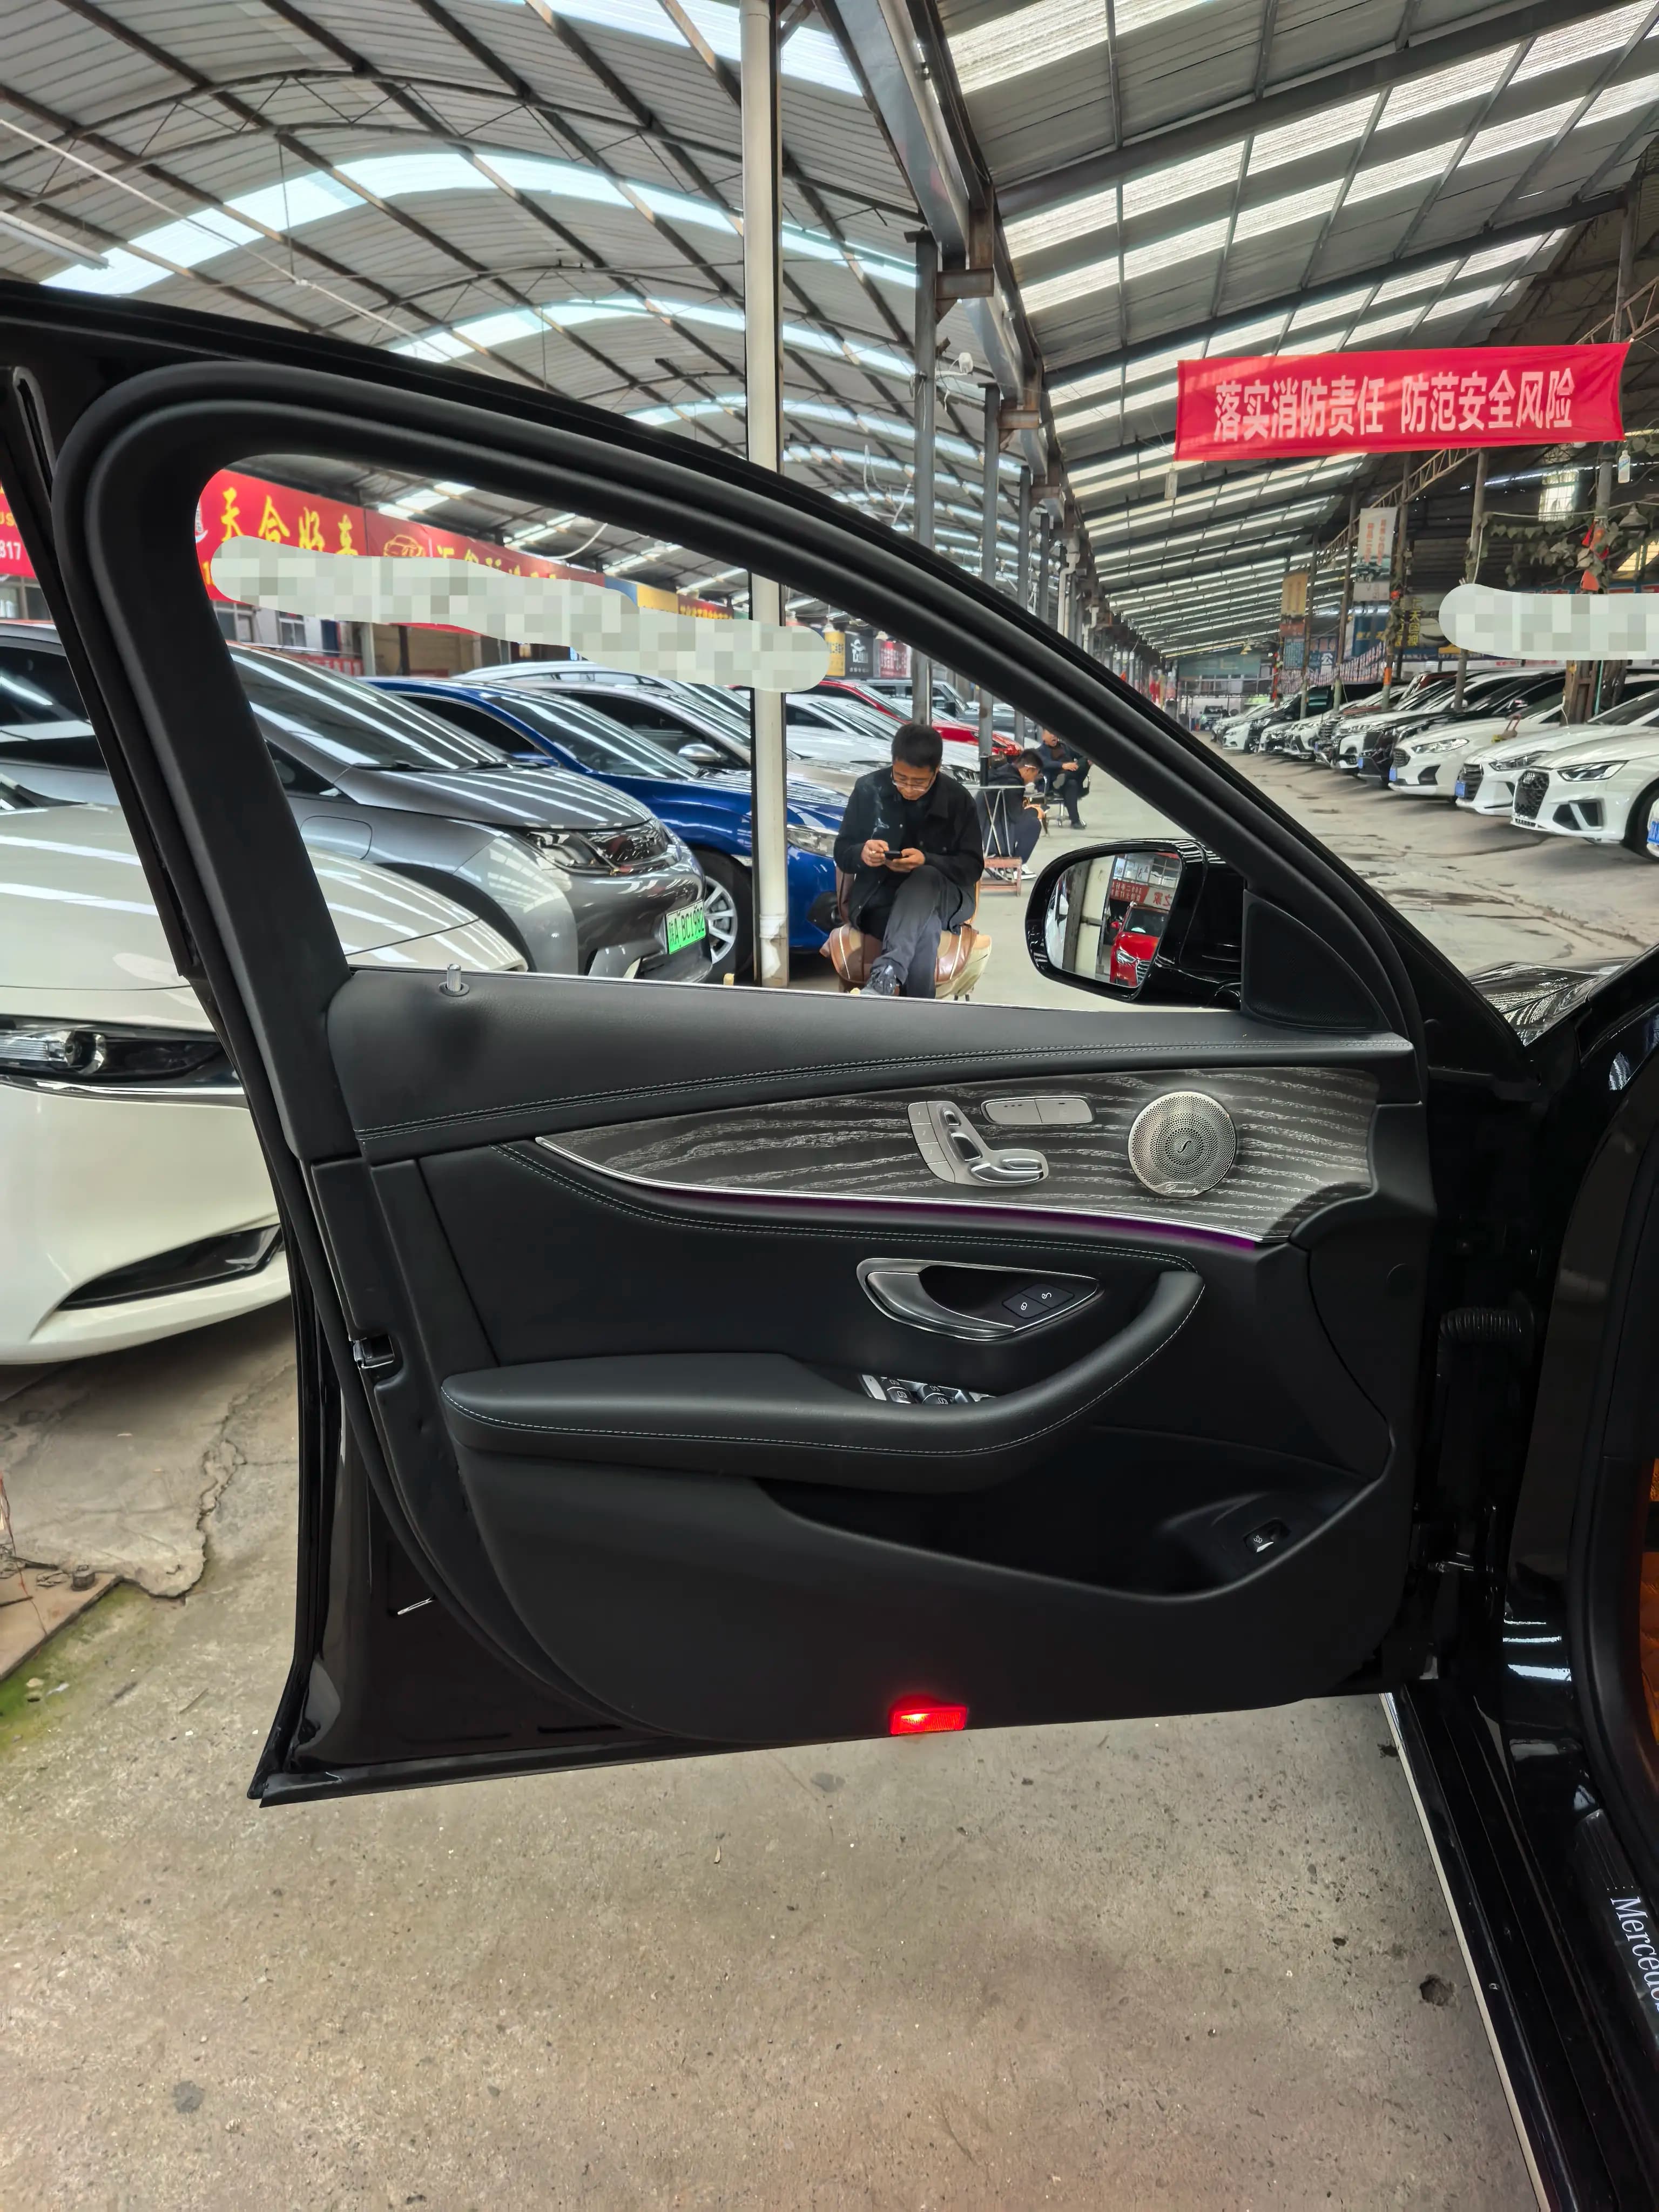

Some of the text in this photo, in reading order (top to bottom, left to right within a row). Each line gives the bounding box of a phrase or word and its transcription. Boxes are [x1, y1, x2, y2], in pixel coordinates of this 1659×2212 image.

[1214, 368, 1575, 442] 落实消防责任 防范安全风险
